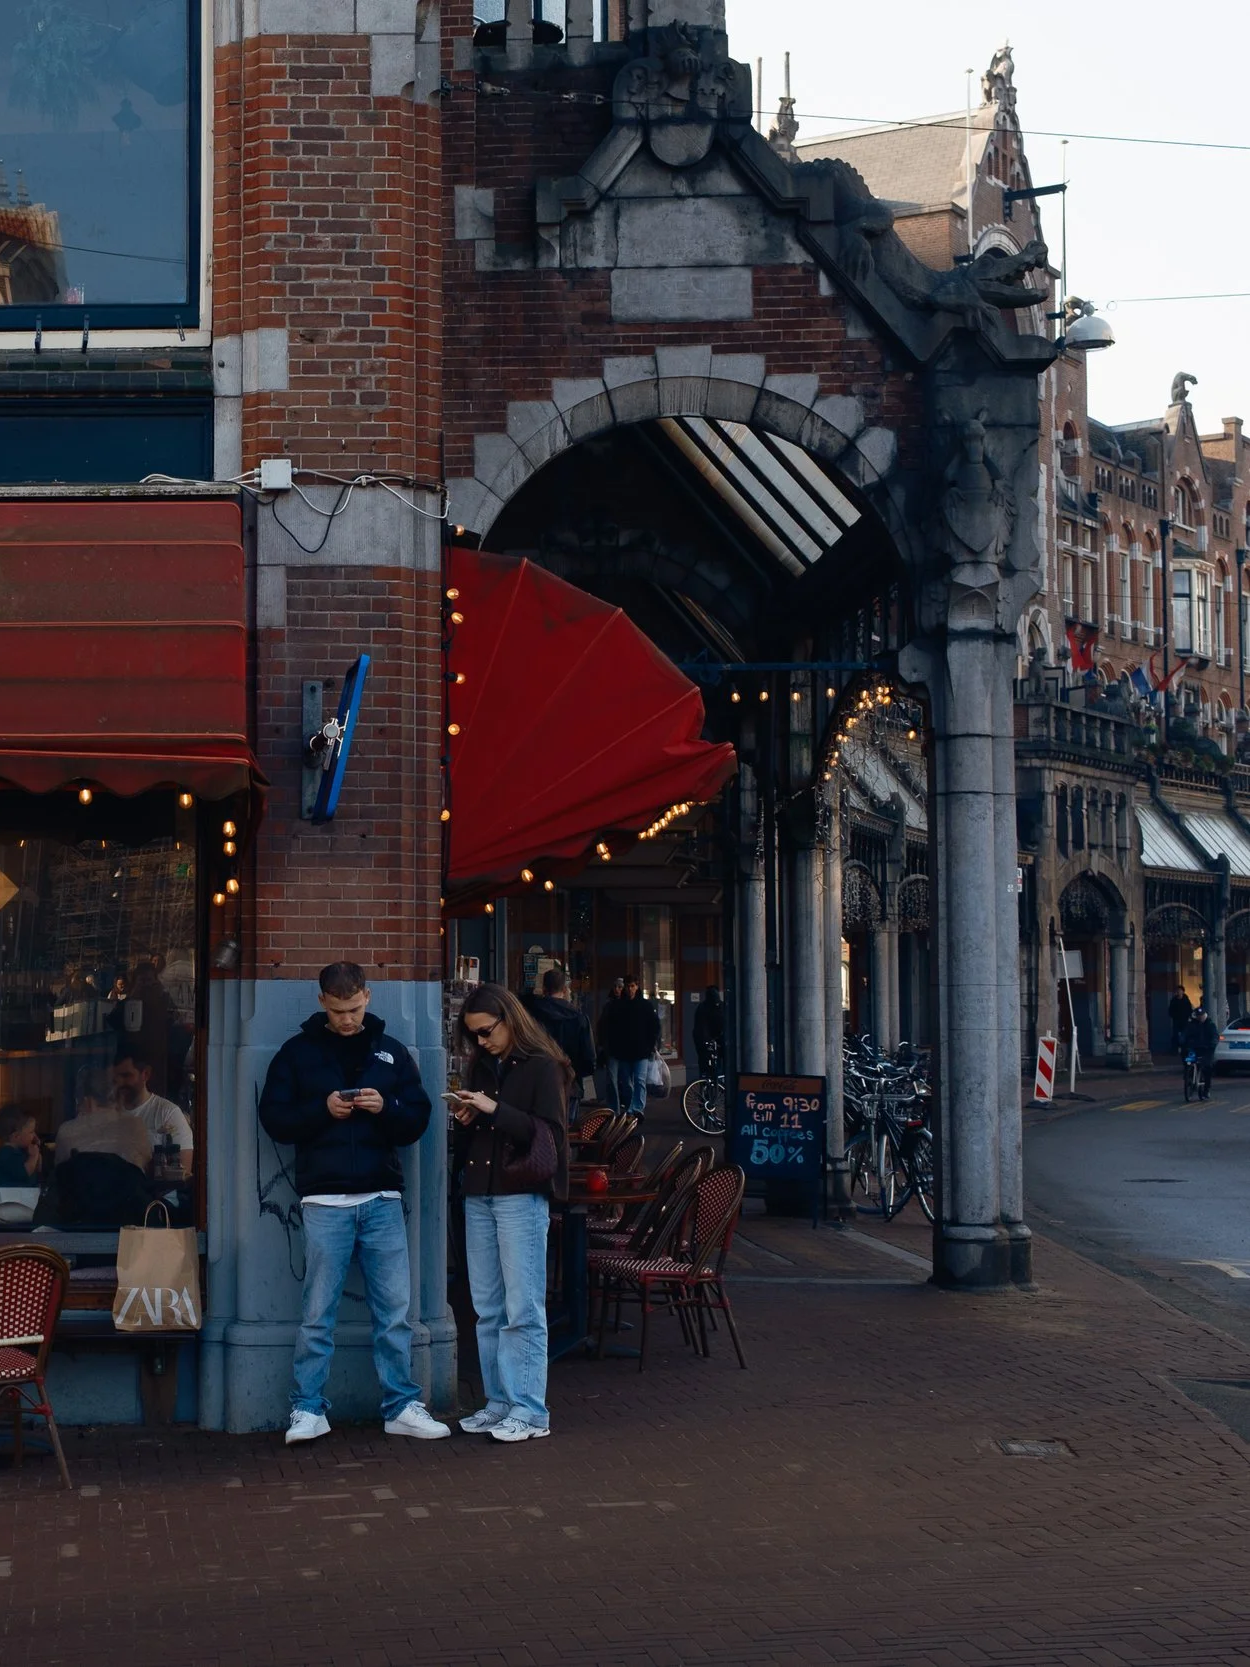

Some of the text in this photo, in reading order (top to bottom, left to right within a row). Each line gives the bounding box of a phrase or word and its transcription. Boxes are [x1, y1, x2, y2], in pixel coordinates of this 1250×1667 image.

[745, 1092, 820, 1112] from 9:30
[753, 1111, 803, 1128] till 11
[740, 1124, 758, 1137] All
[750, 1138, 804, 1165] 50%
[114, 1286, 198, 1327] ZARA
